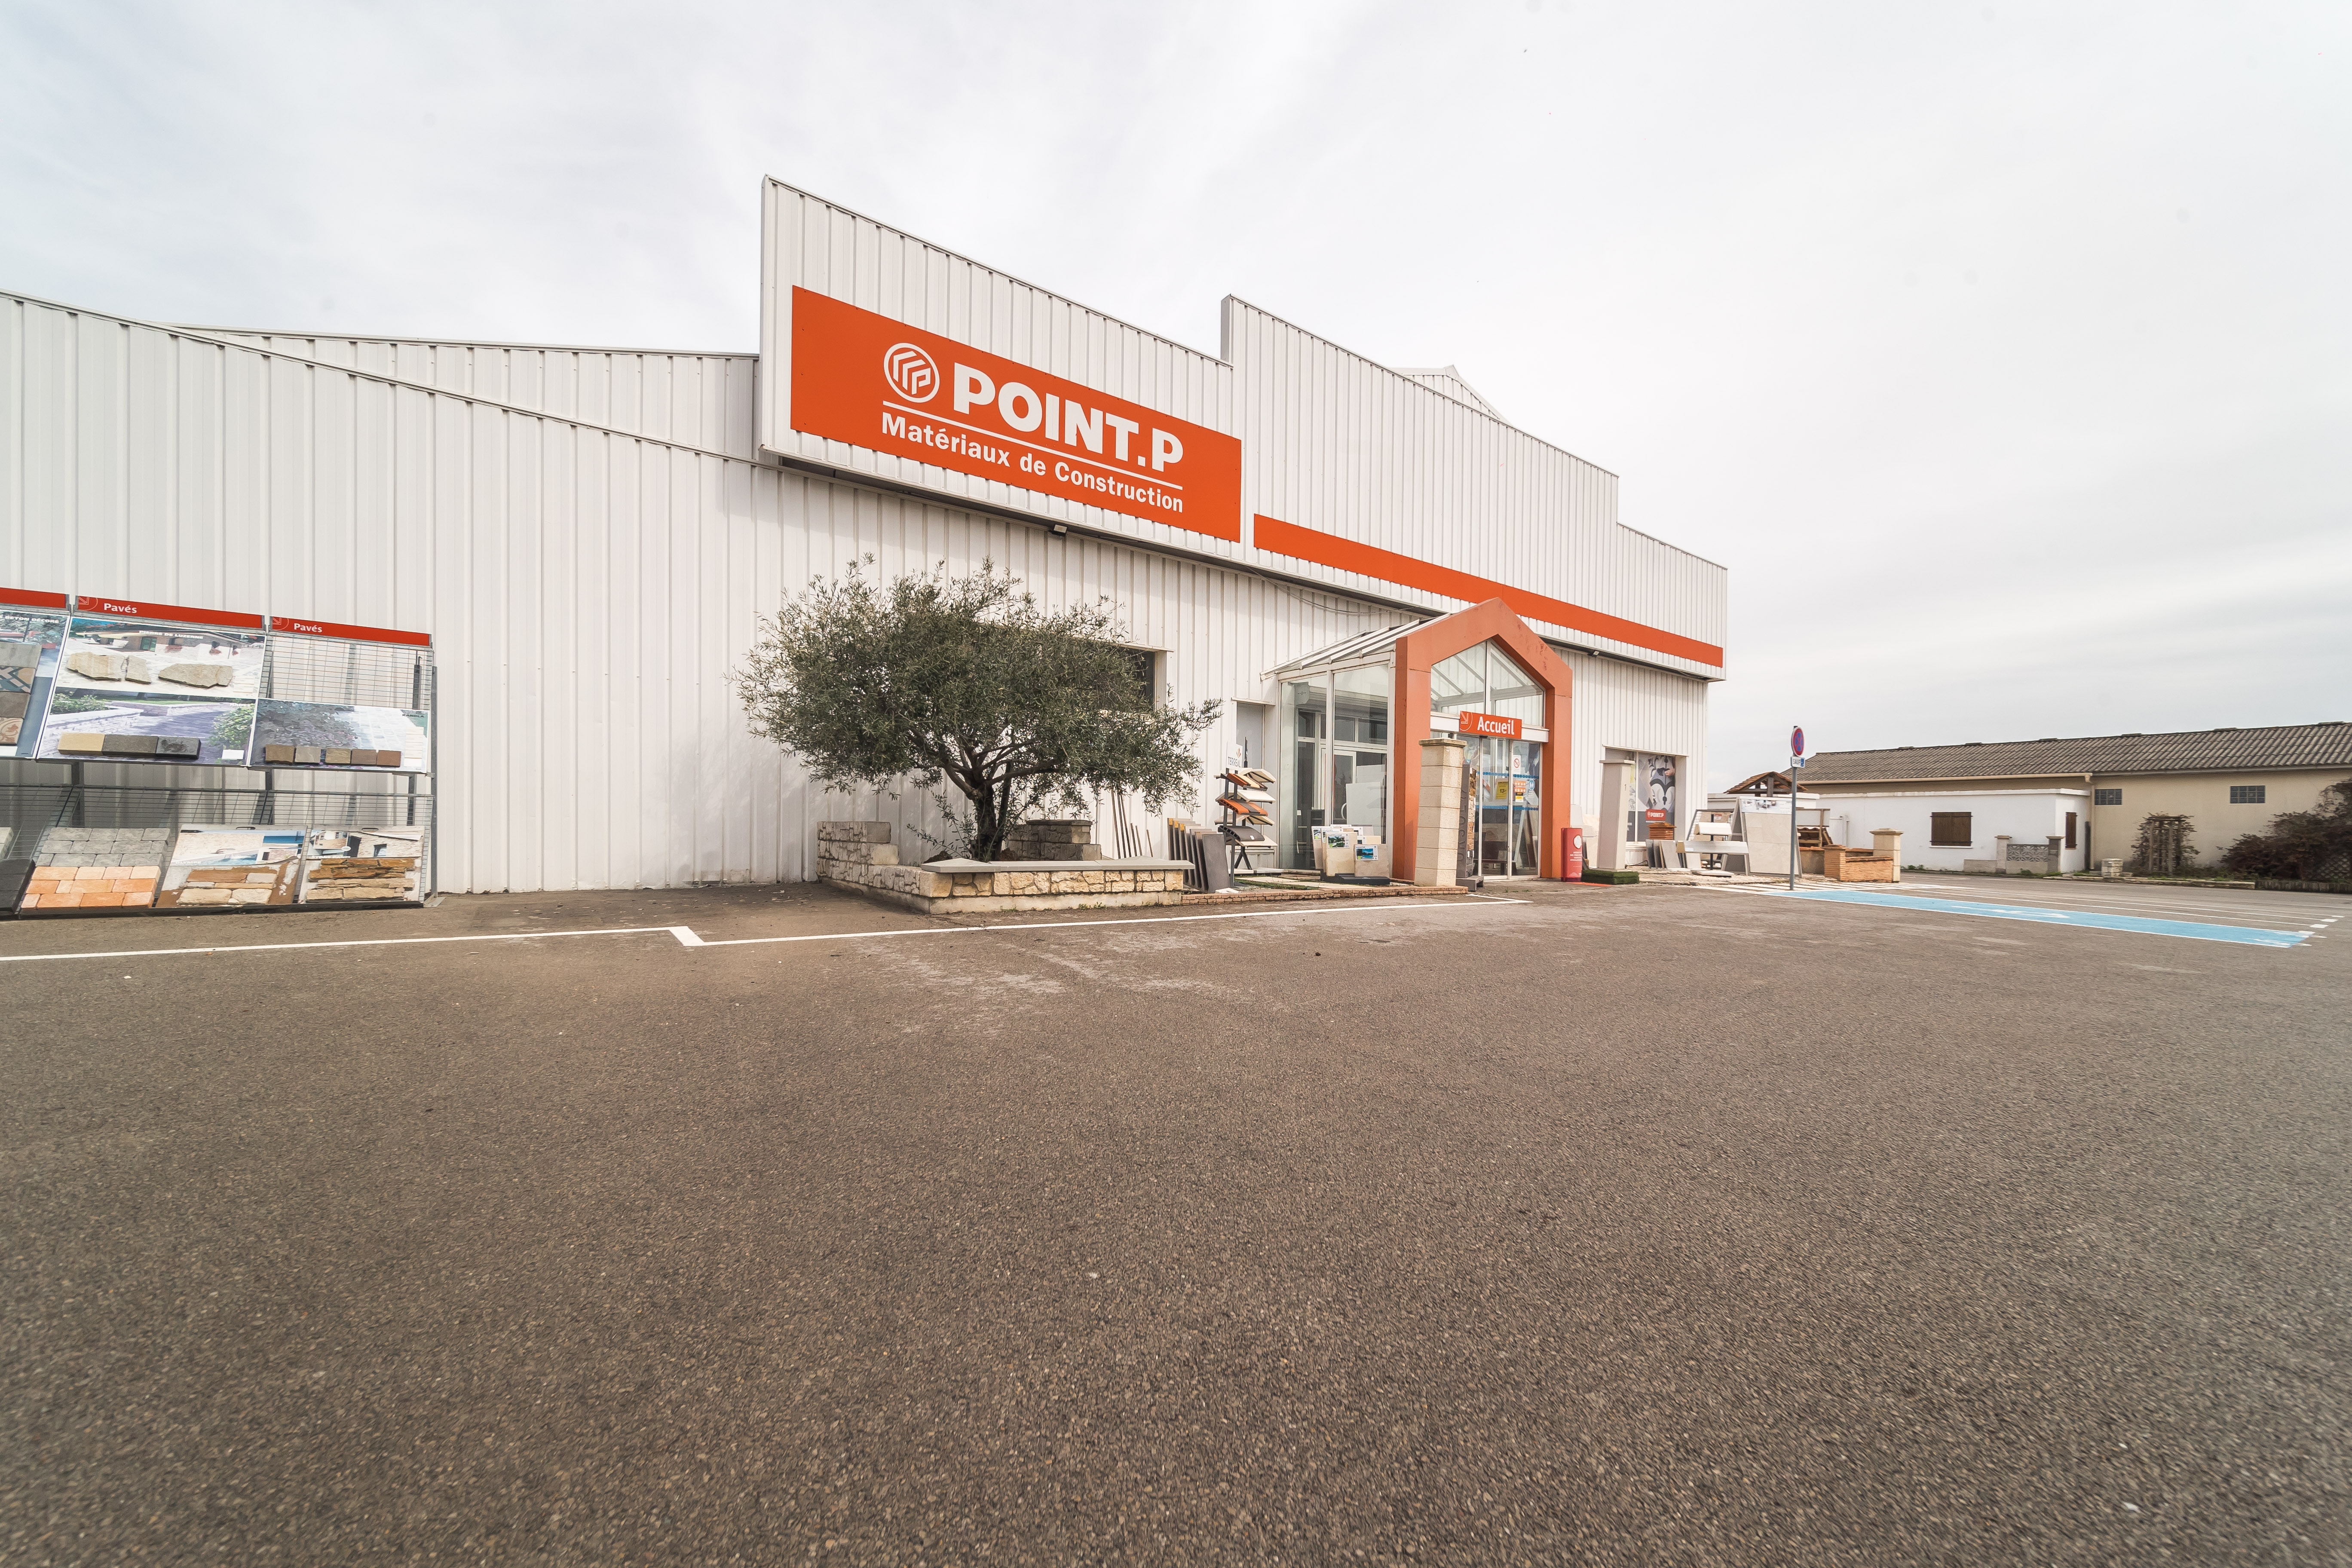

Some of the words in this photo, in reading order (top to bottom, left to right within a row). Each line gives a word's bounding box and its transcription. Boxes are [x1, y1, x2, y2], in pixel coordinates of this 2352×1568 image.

[953, 362, 1184, 472] POINT.P
[882, 411, 1010, 467] Matériaux
[1020, 453, 1046, 476] de
[1055, 461, 1183, 513] Construction
[104, 603, 137, 613] Pavés
[294, 623, 322, 633] Pavés
[1477, 716, 1515, 735] Accueil
[1228, 756, 1241, 768] TERREAL
